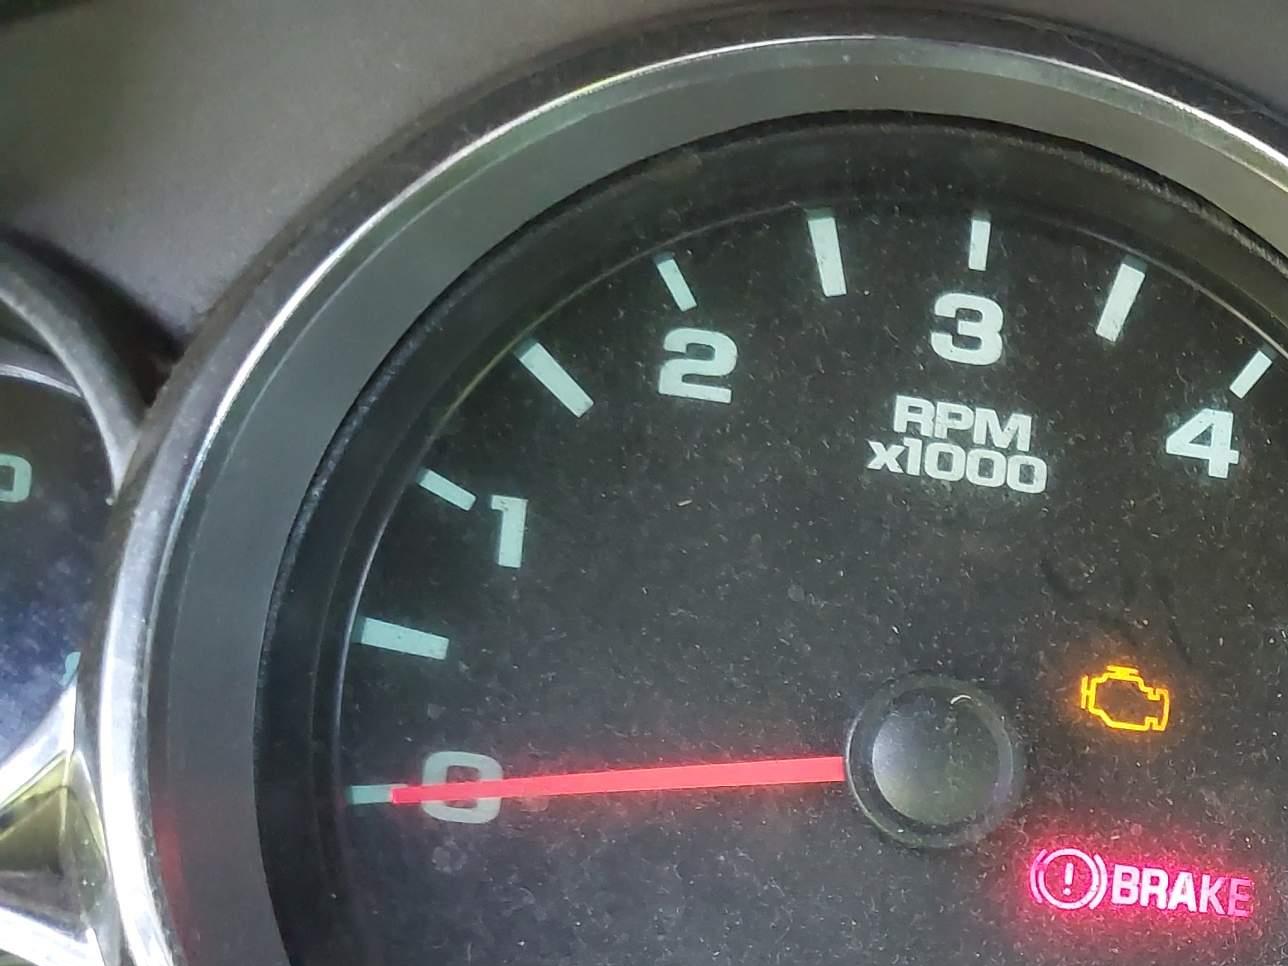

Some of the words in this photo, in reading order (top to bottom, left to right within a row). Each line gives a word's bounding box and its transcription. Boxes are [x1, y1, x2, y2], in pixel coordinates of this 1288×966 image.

[930, 293, 1003, 365] 3
[658, 326, 738, 404] 2
[893, 395, 1032, 452] RPM
[1165, 408, 1240, 479] 4
[866, 437, 1047, 494] x1000
[490, 494, 528, 569] 1
[421, 751, 503, 824] 0
[1111, 864, 1254, 918] BRAKE
